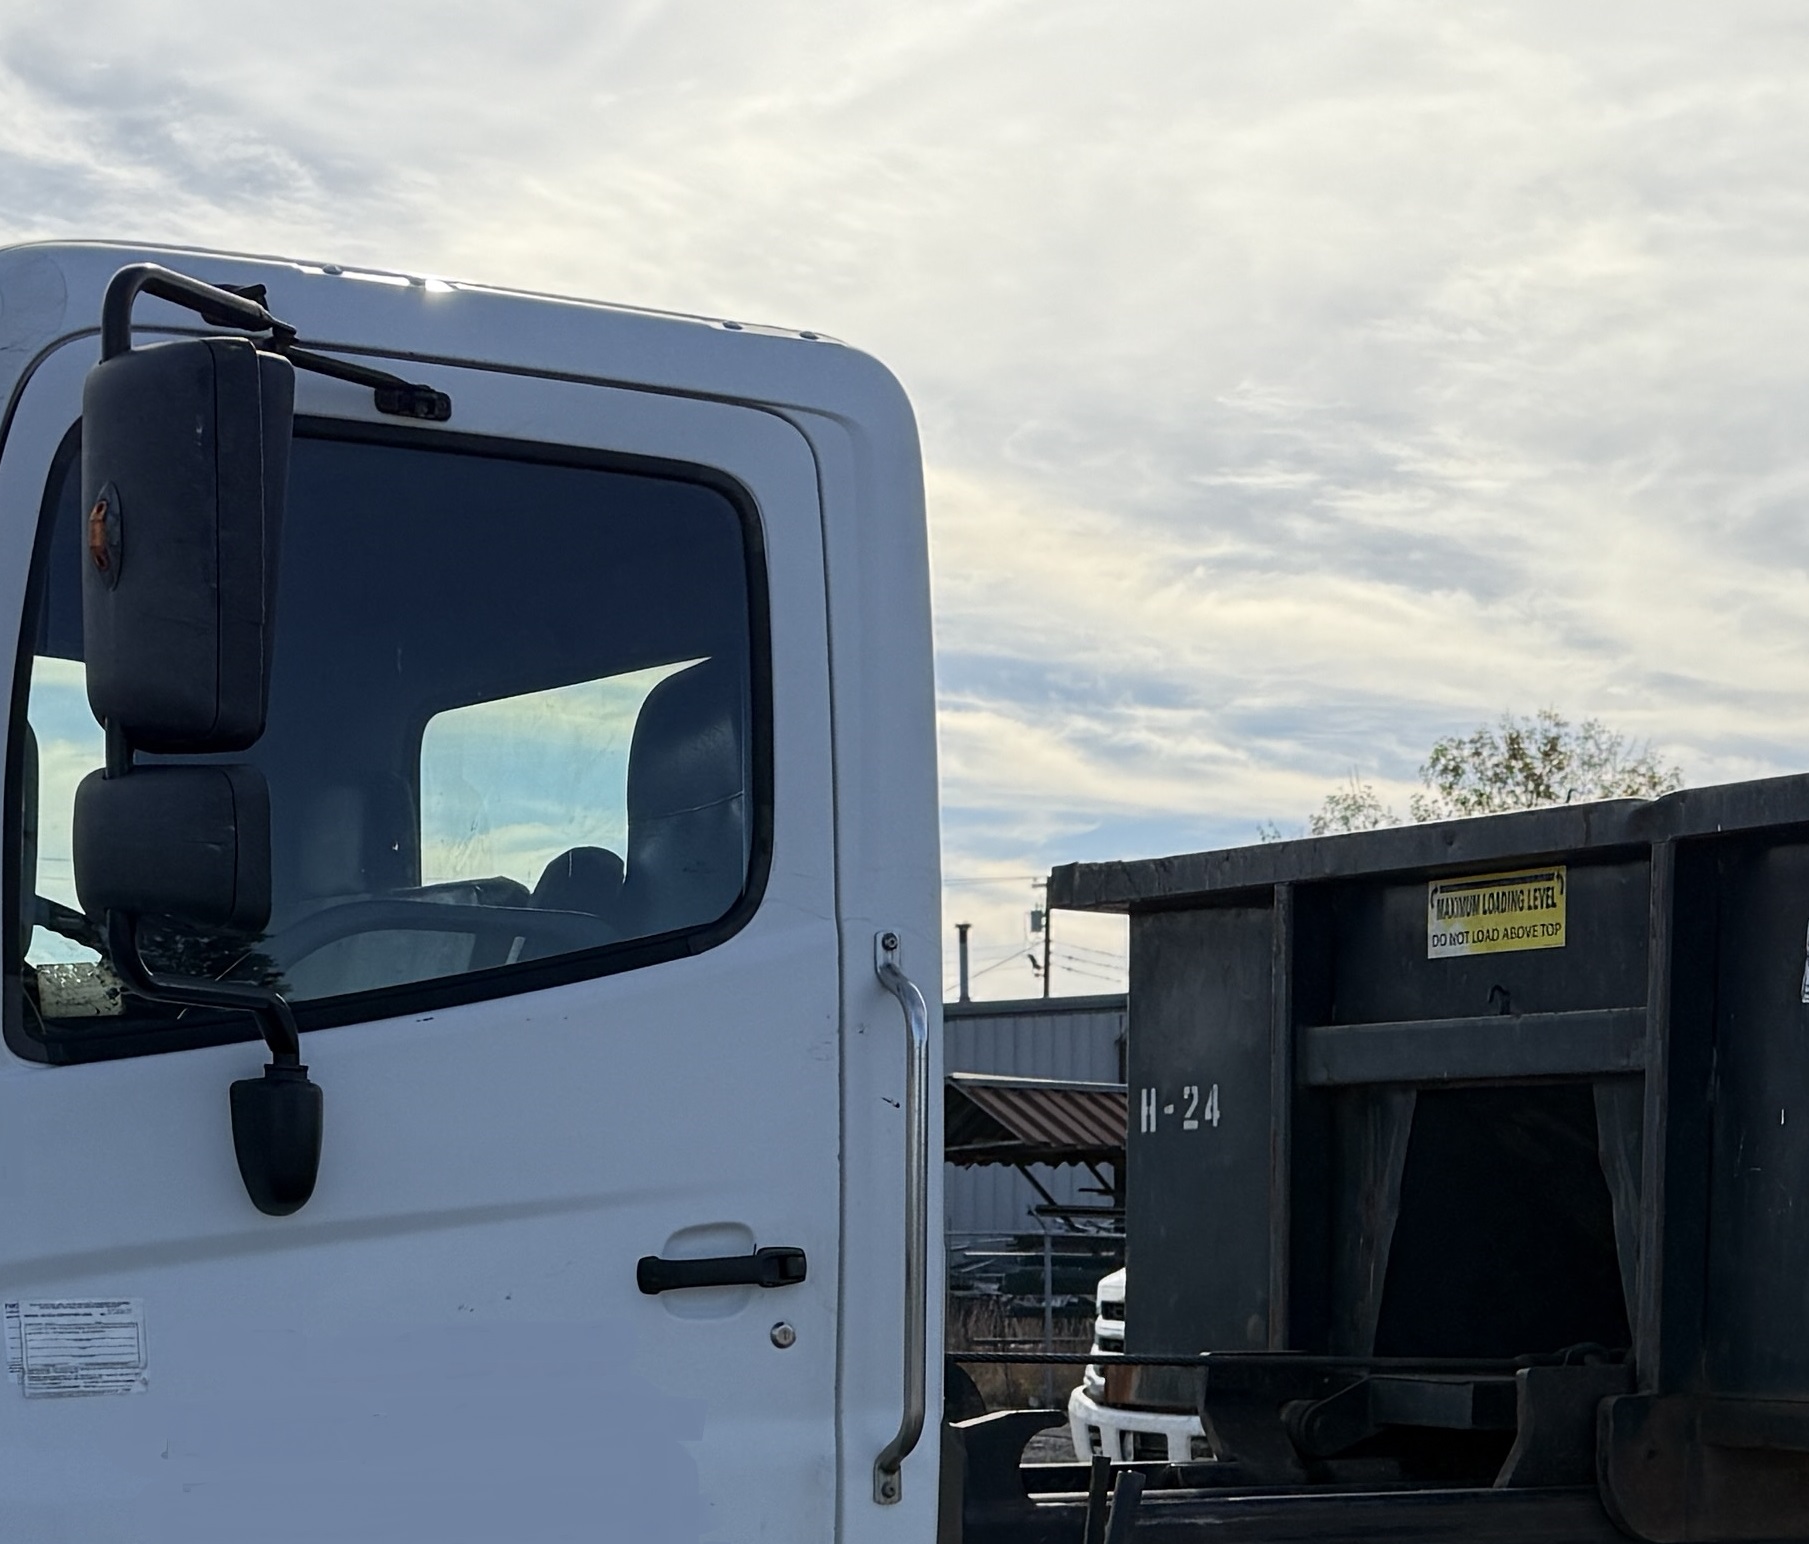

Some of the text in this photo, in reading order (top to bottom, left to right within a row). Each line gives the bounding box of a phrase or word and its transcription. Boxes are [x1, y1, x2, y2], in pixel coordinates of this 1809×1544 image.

[1436, 886, 1557, 921] MAXIMUM LOADING LEVEL
[1432, 922, 1562, 948] DO NOT LOAD ABOVE TOP
[1140, 1083, 1221, 1133] H-24
